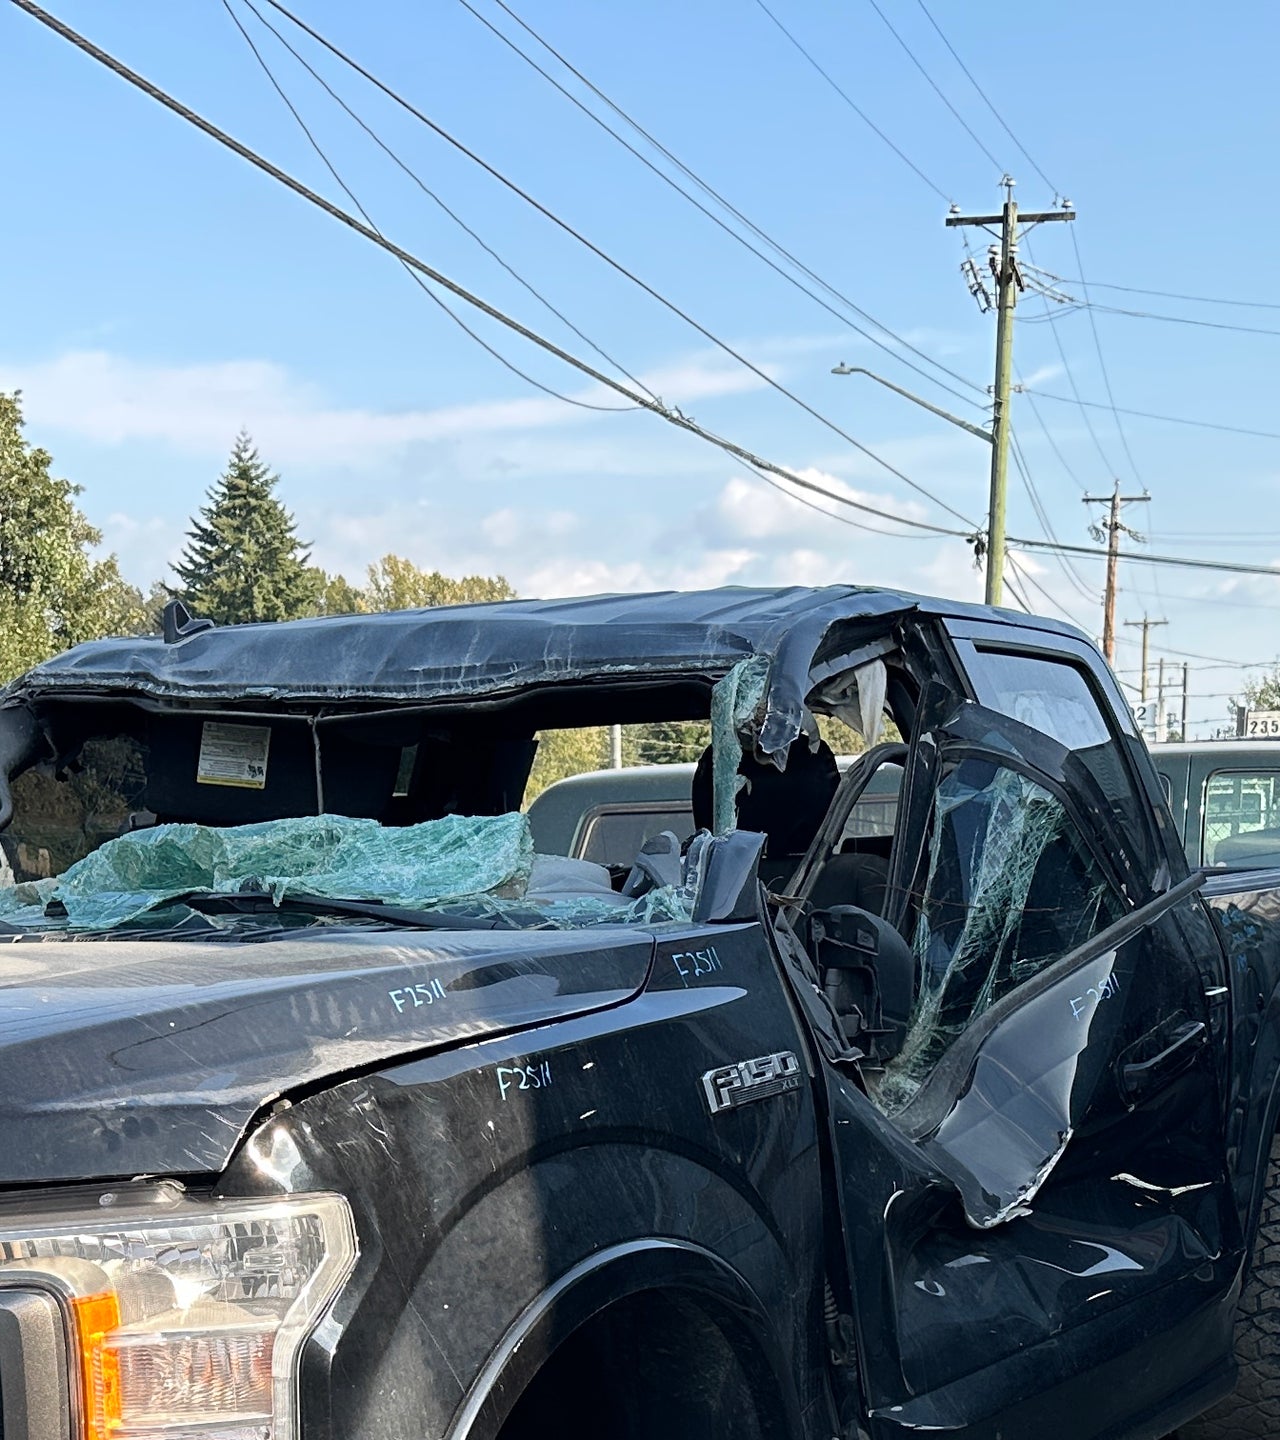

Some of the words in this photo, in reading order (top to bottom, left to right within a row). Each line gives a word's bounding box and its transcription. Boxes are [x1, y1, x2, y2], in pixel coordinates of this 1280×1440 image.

[672, 946, 723, 989] F2511
[388, 977, 447, 1014] F2511
[496, 1060, 551, 1101] F2511
[781, 1077, 799, 1090] XLT
